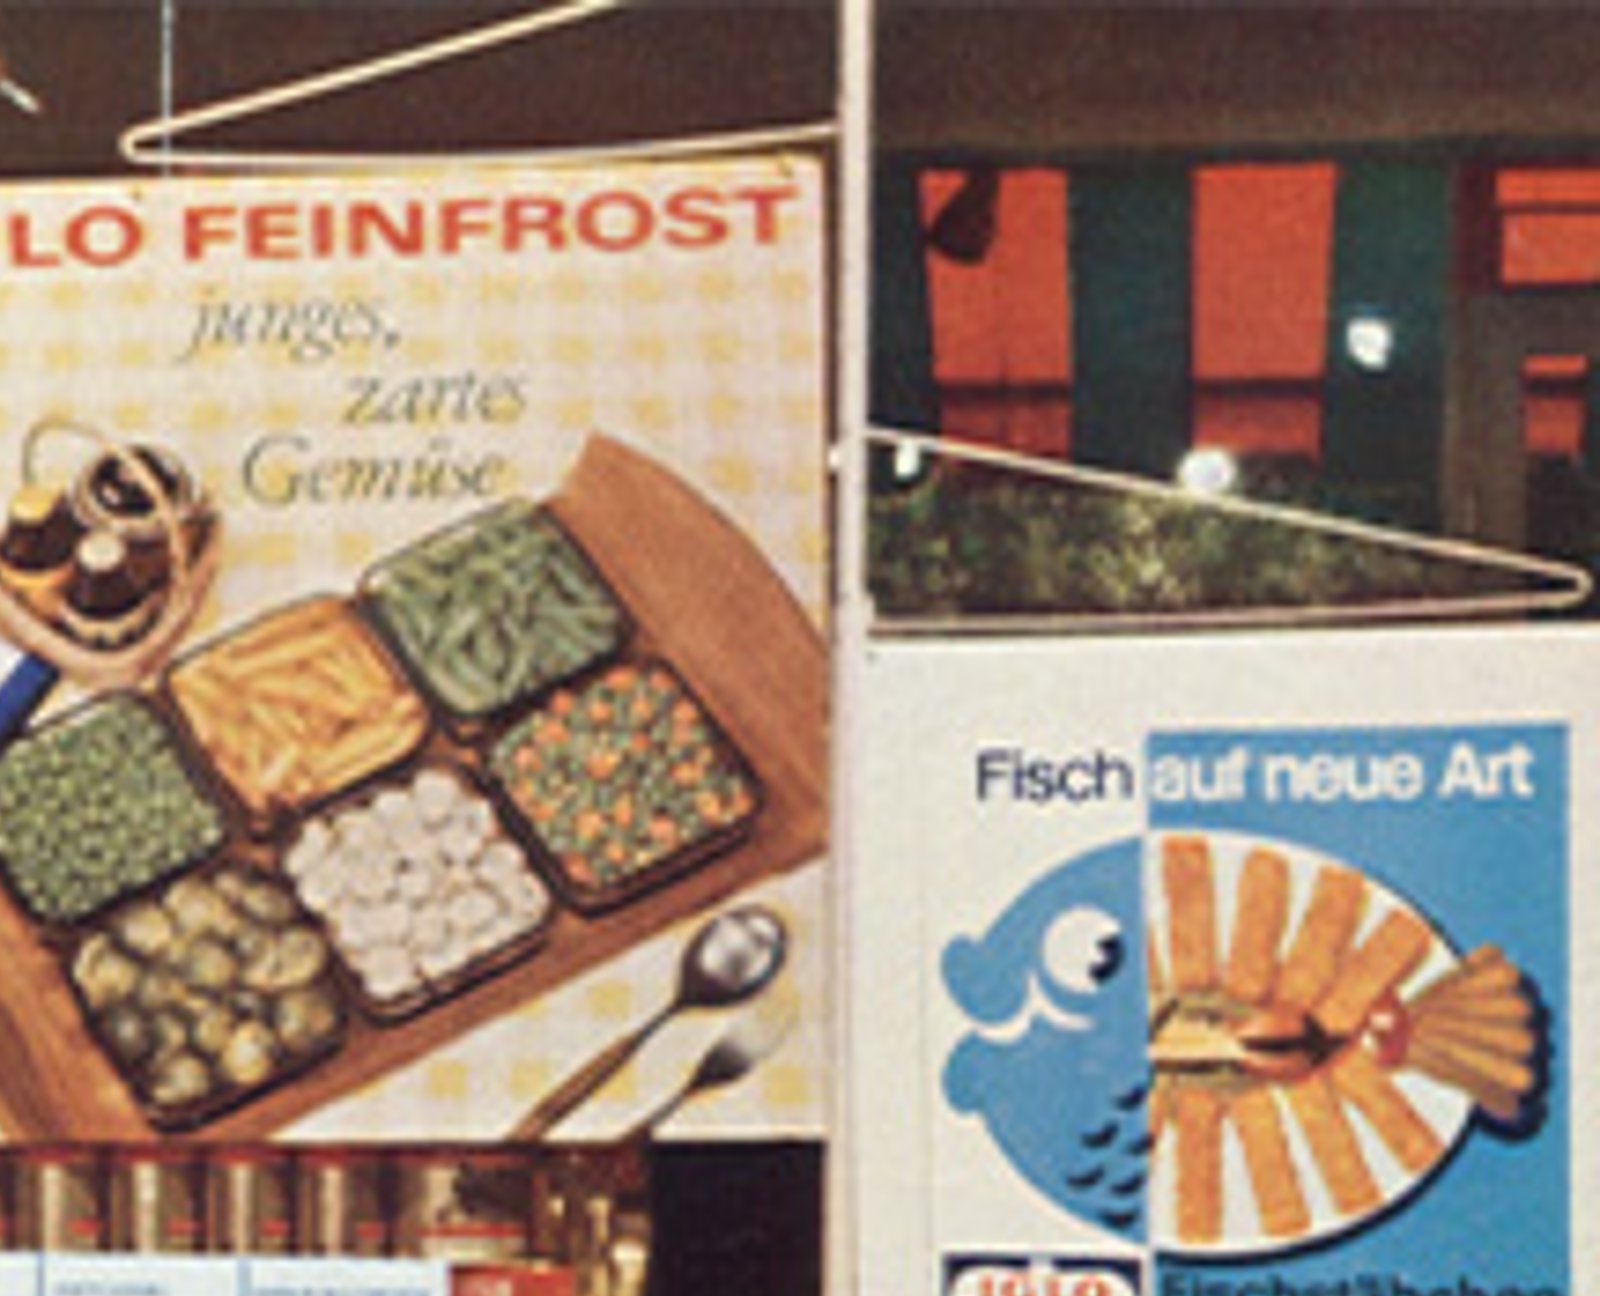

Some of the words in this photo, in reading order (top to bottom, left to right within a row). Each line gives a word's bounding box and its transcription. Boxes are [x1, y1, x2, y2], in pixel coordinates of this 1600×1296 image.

[184, 185, 800, 262] FEINFROST
[173, 290, 401, 365] junges,
[340, 372, 528, 424] zartes
[243, 434, 507, 504] Gemüse
[975, 747, 1134, 802] Fisch
[1152, 743, 1248, 799] auf
[1264, 753, 1423, 800] neue
[1438, 742, 1534, 797] Art
